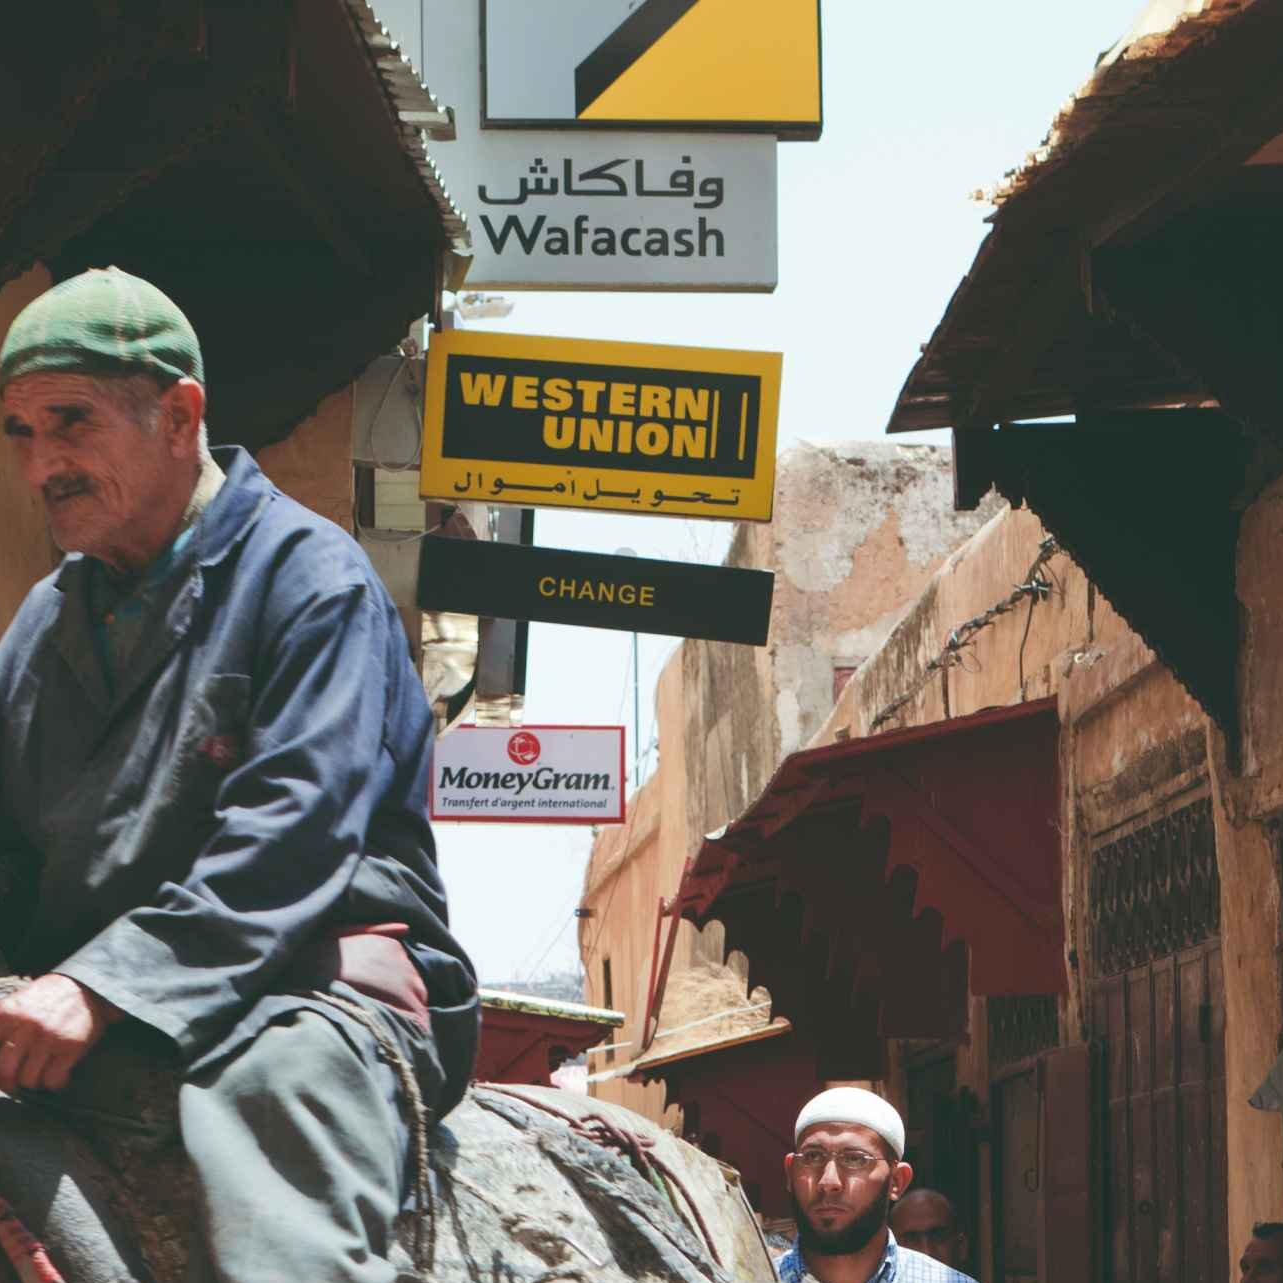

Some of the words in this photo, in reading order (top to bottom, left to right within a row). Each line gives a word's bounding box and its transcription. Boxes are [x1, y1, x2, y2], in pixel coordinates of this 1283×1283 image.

[478, 155, 724, 209] وفاكاش
[479, 214, 725, 258] Wafacash
[460, 372, 709, 421] WESTERN
[542, 415, 706, 459] UNION
[583, 478, 741, 507] تحويل
[538, 576, 656, 606] CHANGE
[439, 766, 611, 795] MoneyGram
[442, 797, 488, 810] Transfert
[491, 797, 535, 811] d'argent
[537, 798, 607, 810] international
